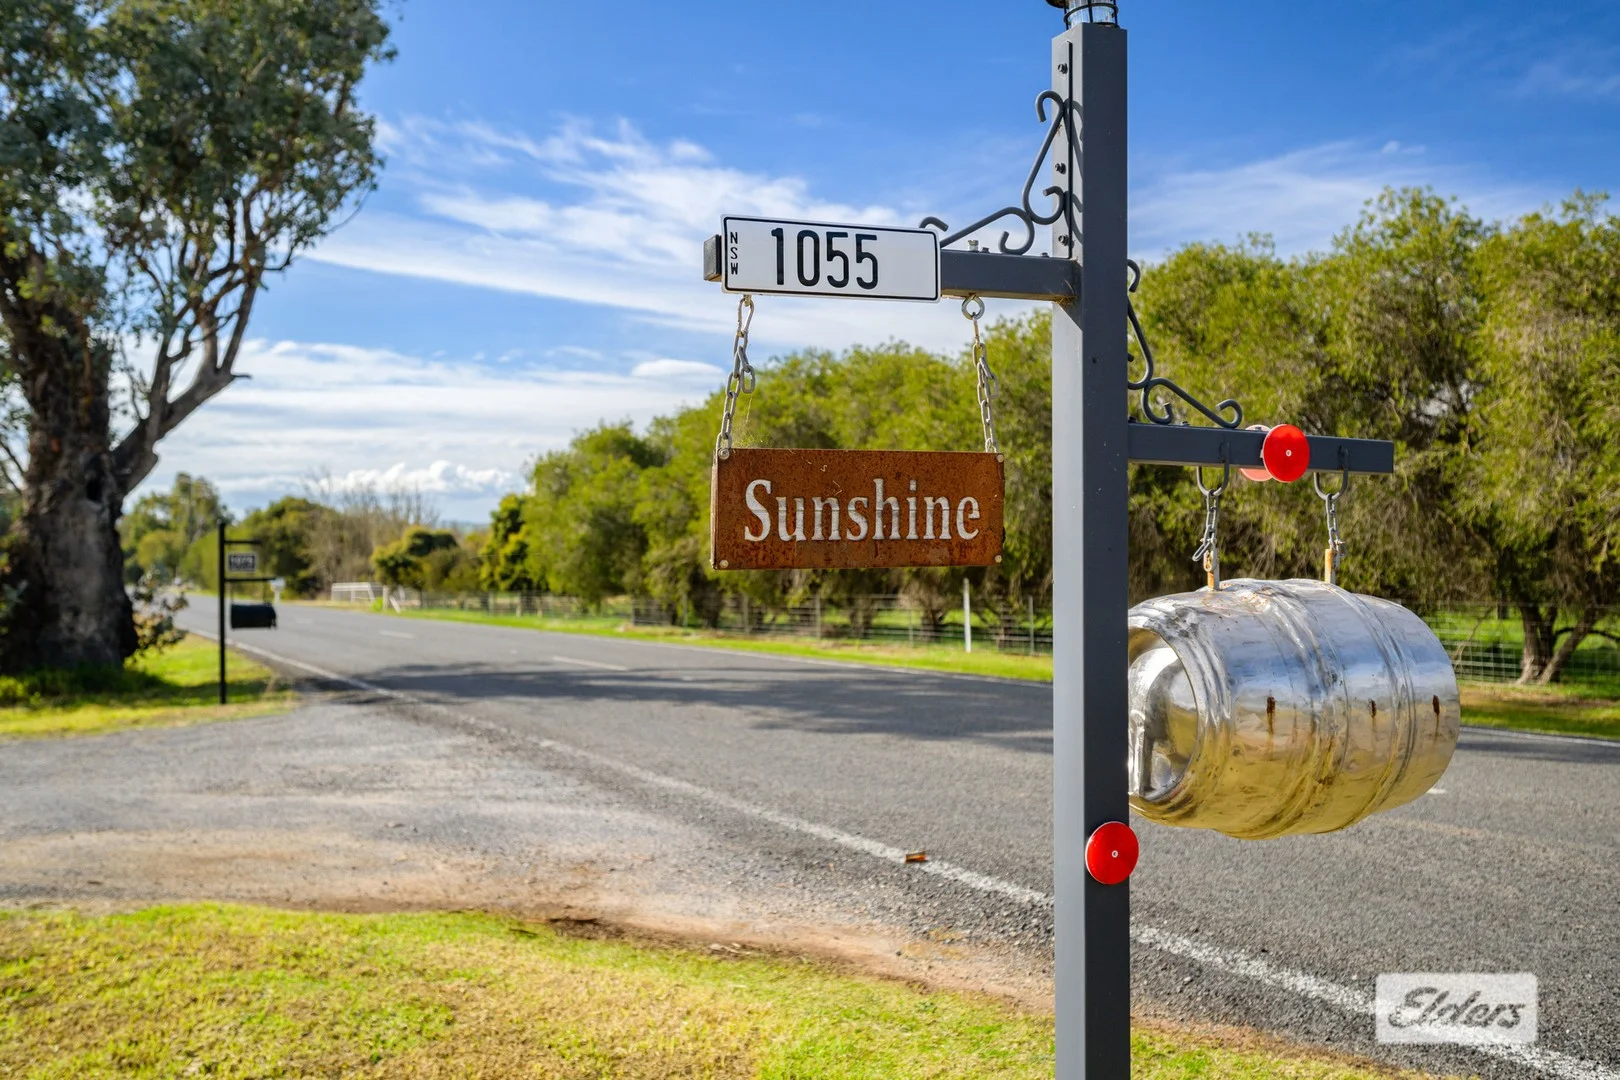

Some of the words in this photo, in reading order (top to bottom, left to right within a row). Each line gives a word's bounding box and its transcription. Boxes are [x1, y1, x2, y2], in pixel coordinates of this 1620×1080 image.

[729, 231, 739, 275] NSW
[771, 227, 879, 290] 1055
[744, 478, 981, 542] Sunshine
